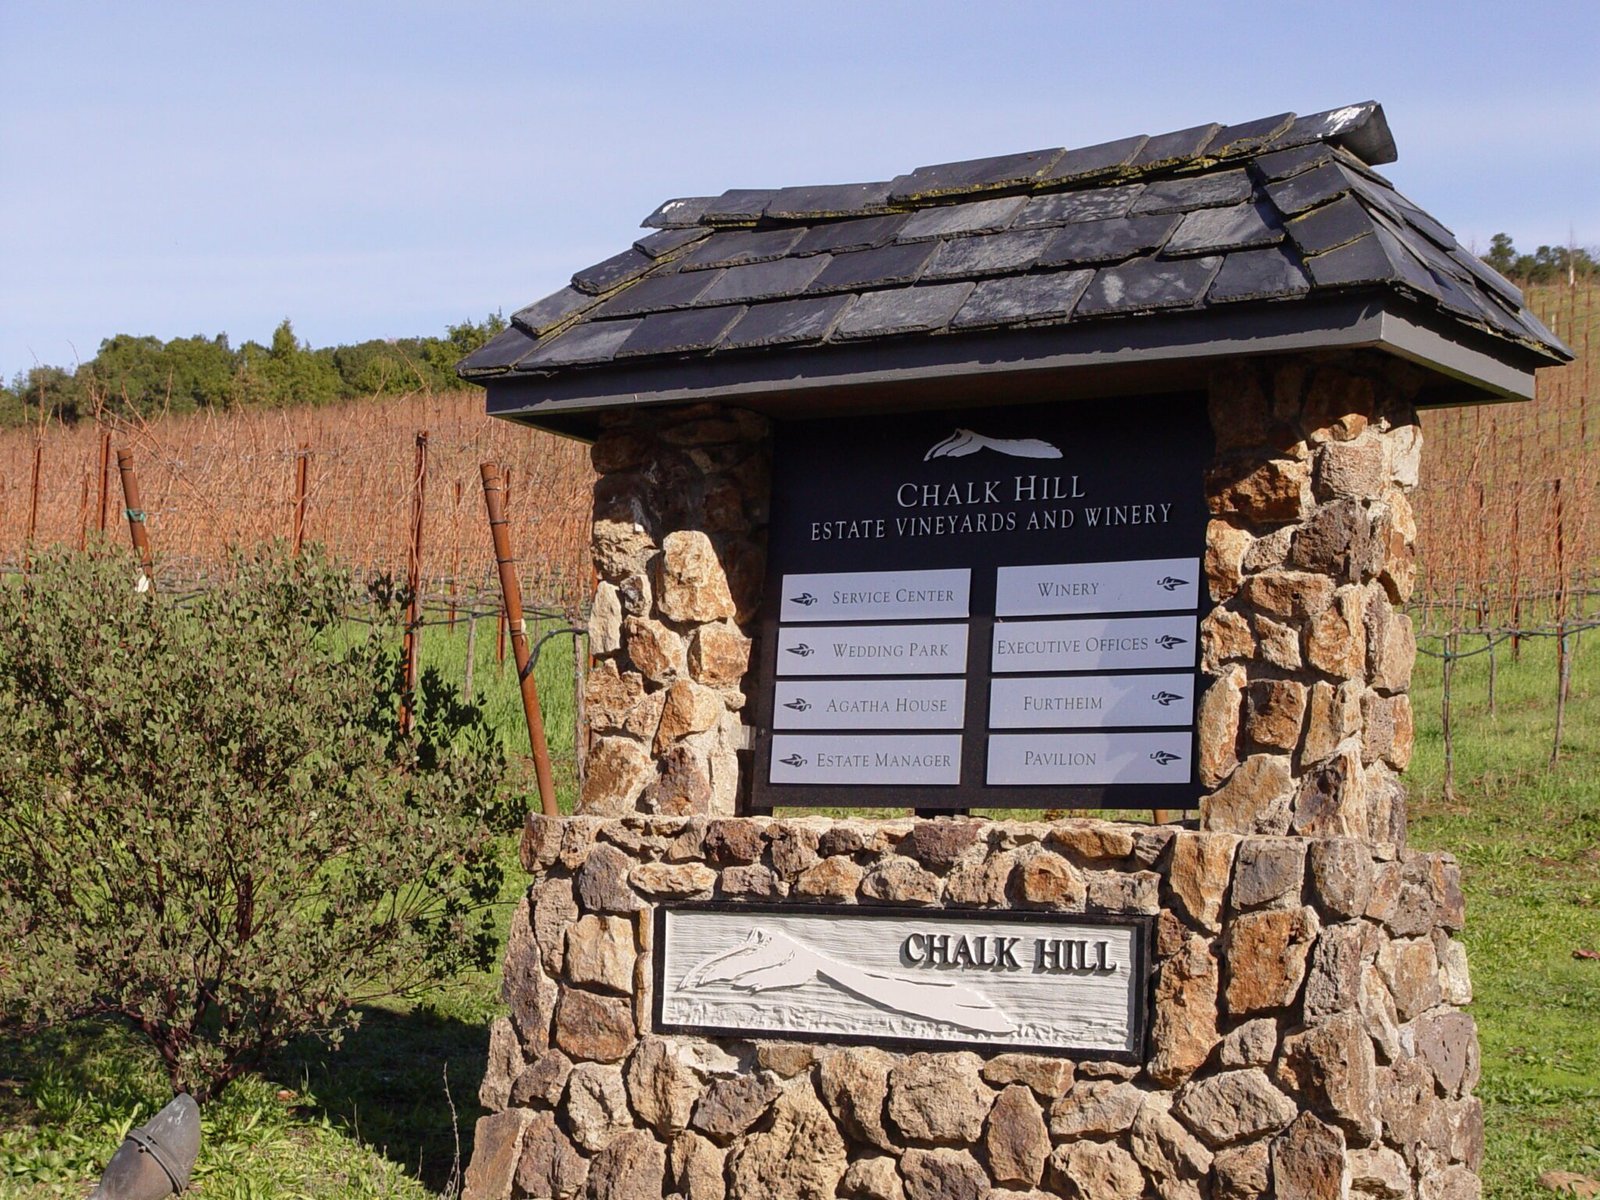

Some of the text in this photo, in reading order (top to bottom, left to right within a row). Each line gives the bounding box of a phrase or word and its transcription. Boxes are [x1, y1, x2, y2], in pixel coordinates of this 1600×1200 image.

[897, 475, 1086, 508] CHALK HILL
[811, 503, 1173, 541] ESTATE VINEYARDS AND WINERY
[832, 589, 954, 605] SERVICE CENTER
[1037, 582, 1100, 597] WINERY
[833, 642, 949, 658] WEDDING PARK
[997, 636, 1149, 655] EXECUTIVE OFFICES
[826, 698, 948, 713] AGATHA HOUSE
[1023, 696, 1103, 711] FURTHEIM
[816, 752, 951, 768] ESTATE MANAGER
[1024, 751, 1097, 766] PAVILION
[903, 933, 1117, 973] CHALK HILL
